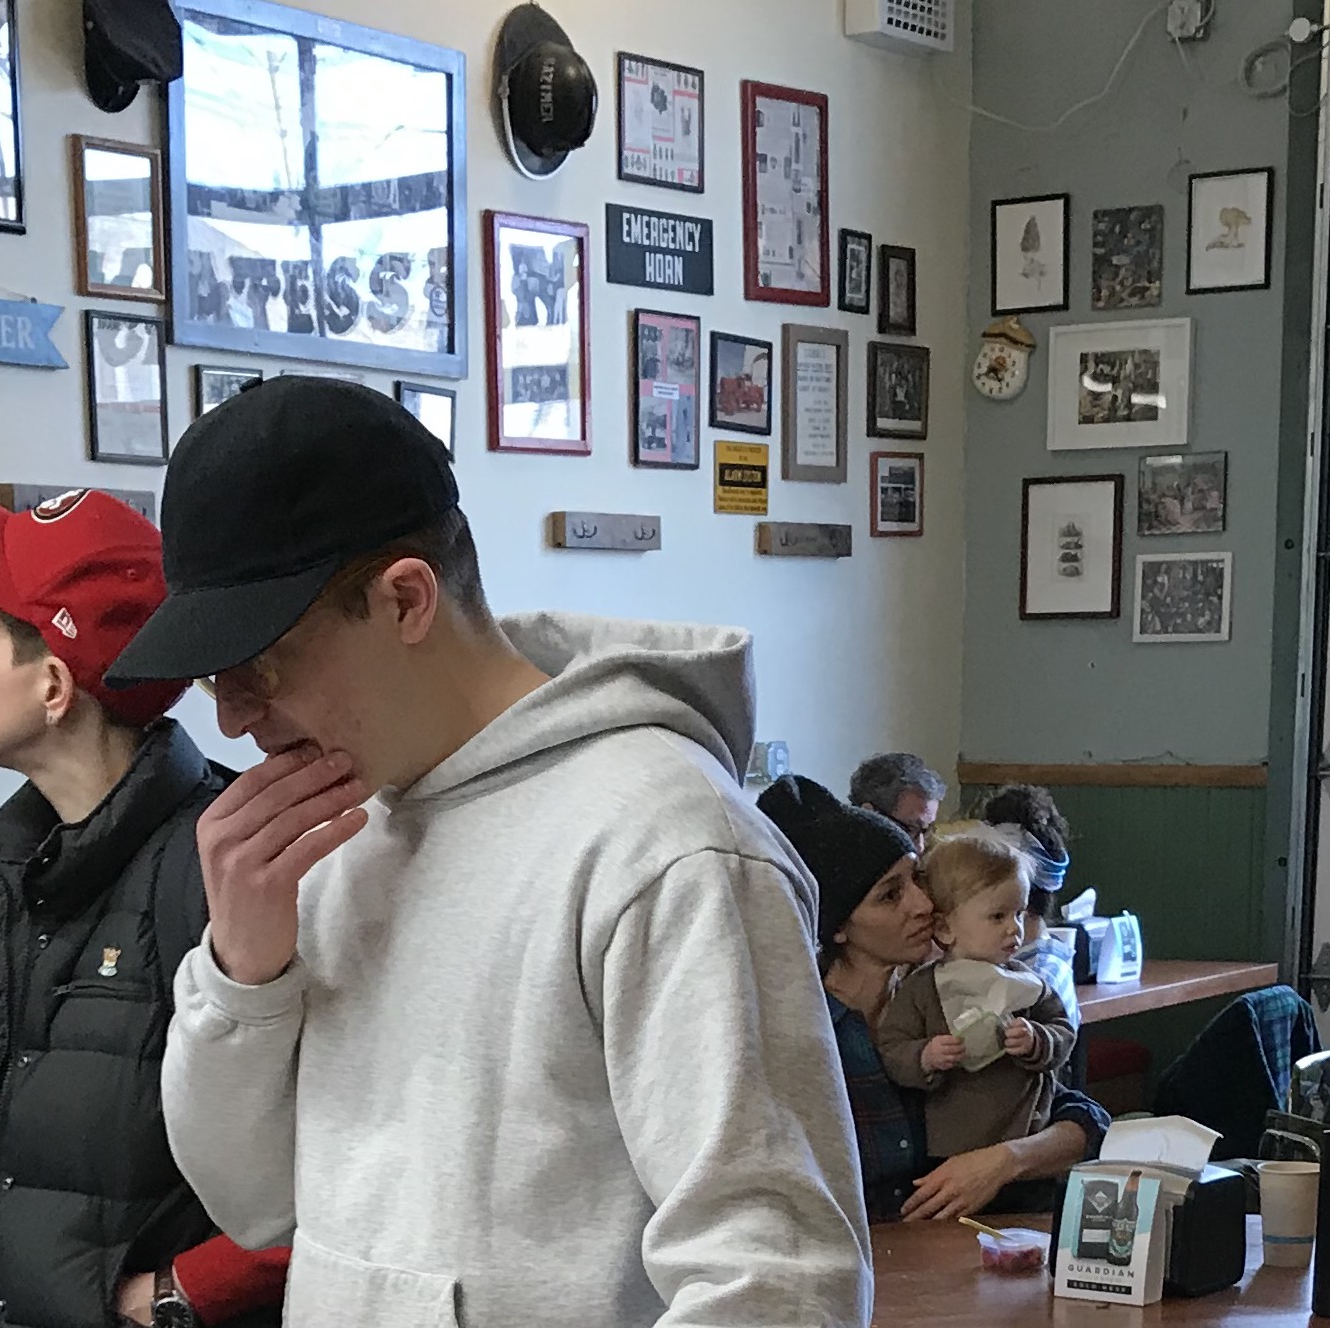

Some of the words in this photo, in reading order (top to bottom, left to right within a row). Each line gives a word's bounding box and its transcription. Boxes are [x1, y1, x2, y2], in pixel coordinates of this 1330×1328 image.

[622, 212, 702, 253] EMERGENCY
[645, 251, 684, 286] HORN
[1067, 1263, 1135, 1279] GUARDIAN
